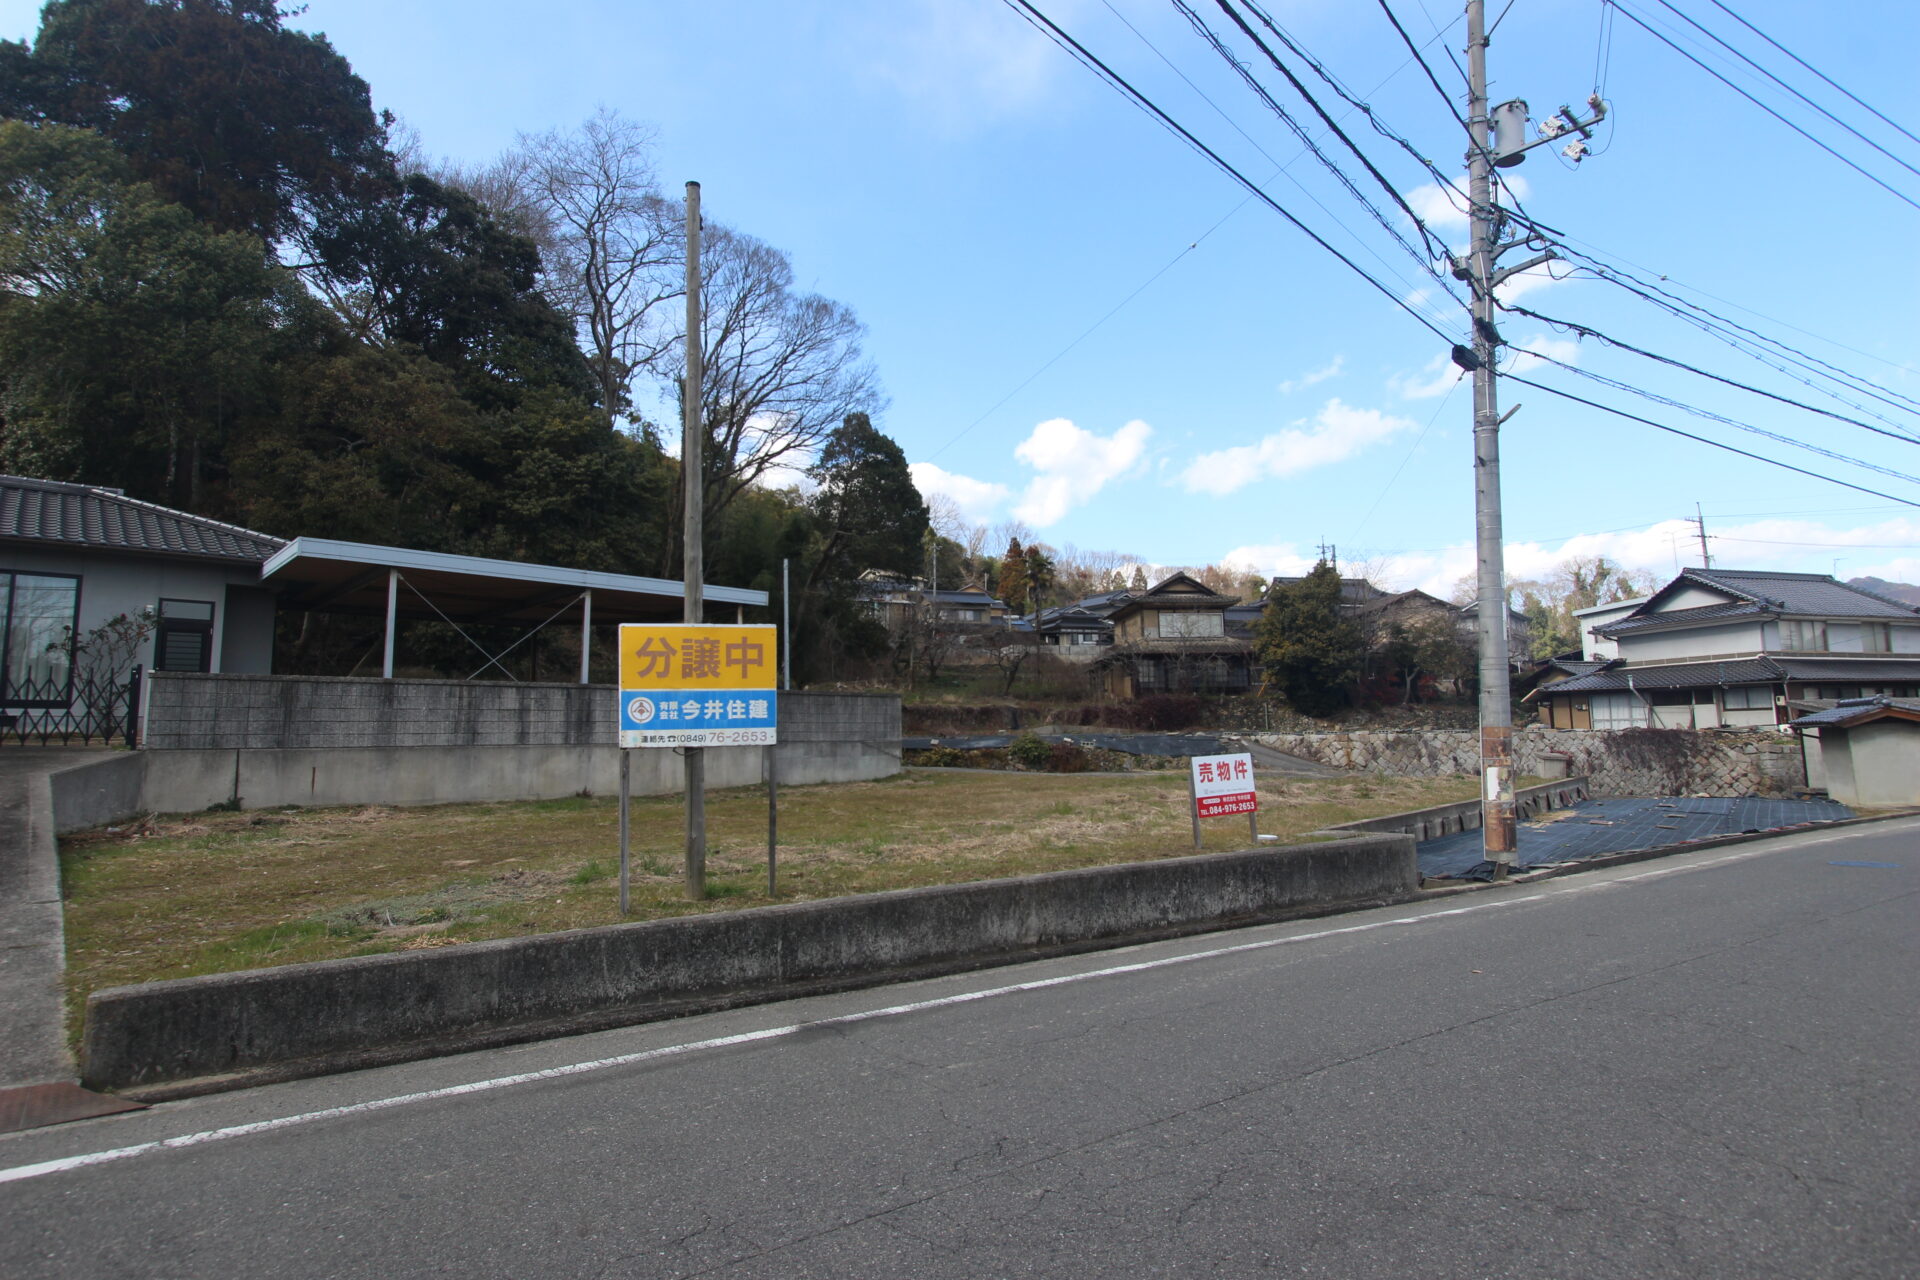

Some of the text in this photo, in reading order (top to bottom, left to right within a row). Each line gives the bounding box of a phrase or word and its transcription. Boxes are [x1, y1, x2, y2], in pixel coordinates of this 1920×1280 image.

[635, 636, 764, 679] 分譲中
[659, 701, 679, 710] 有限
[659, 710, 679, 720] 会社
[681, 699, 769, 720] 今井住建
[1198, 759, 1248, 783] 売物件
